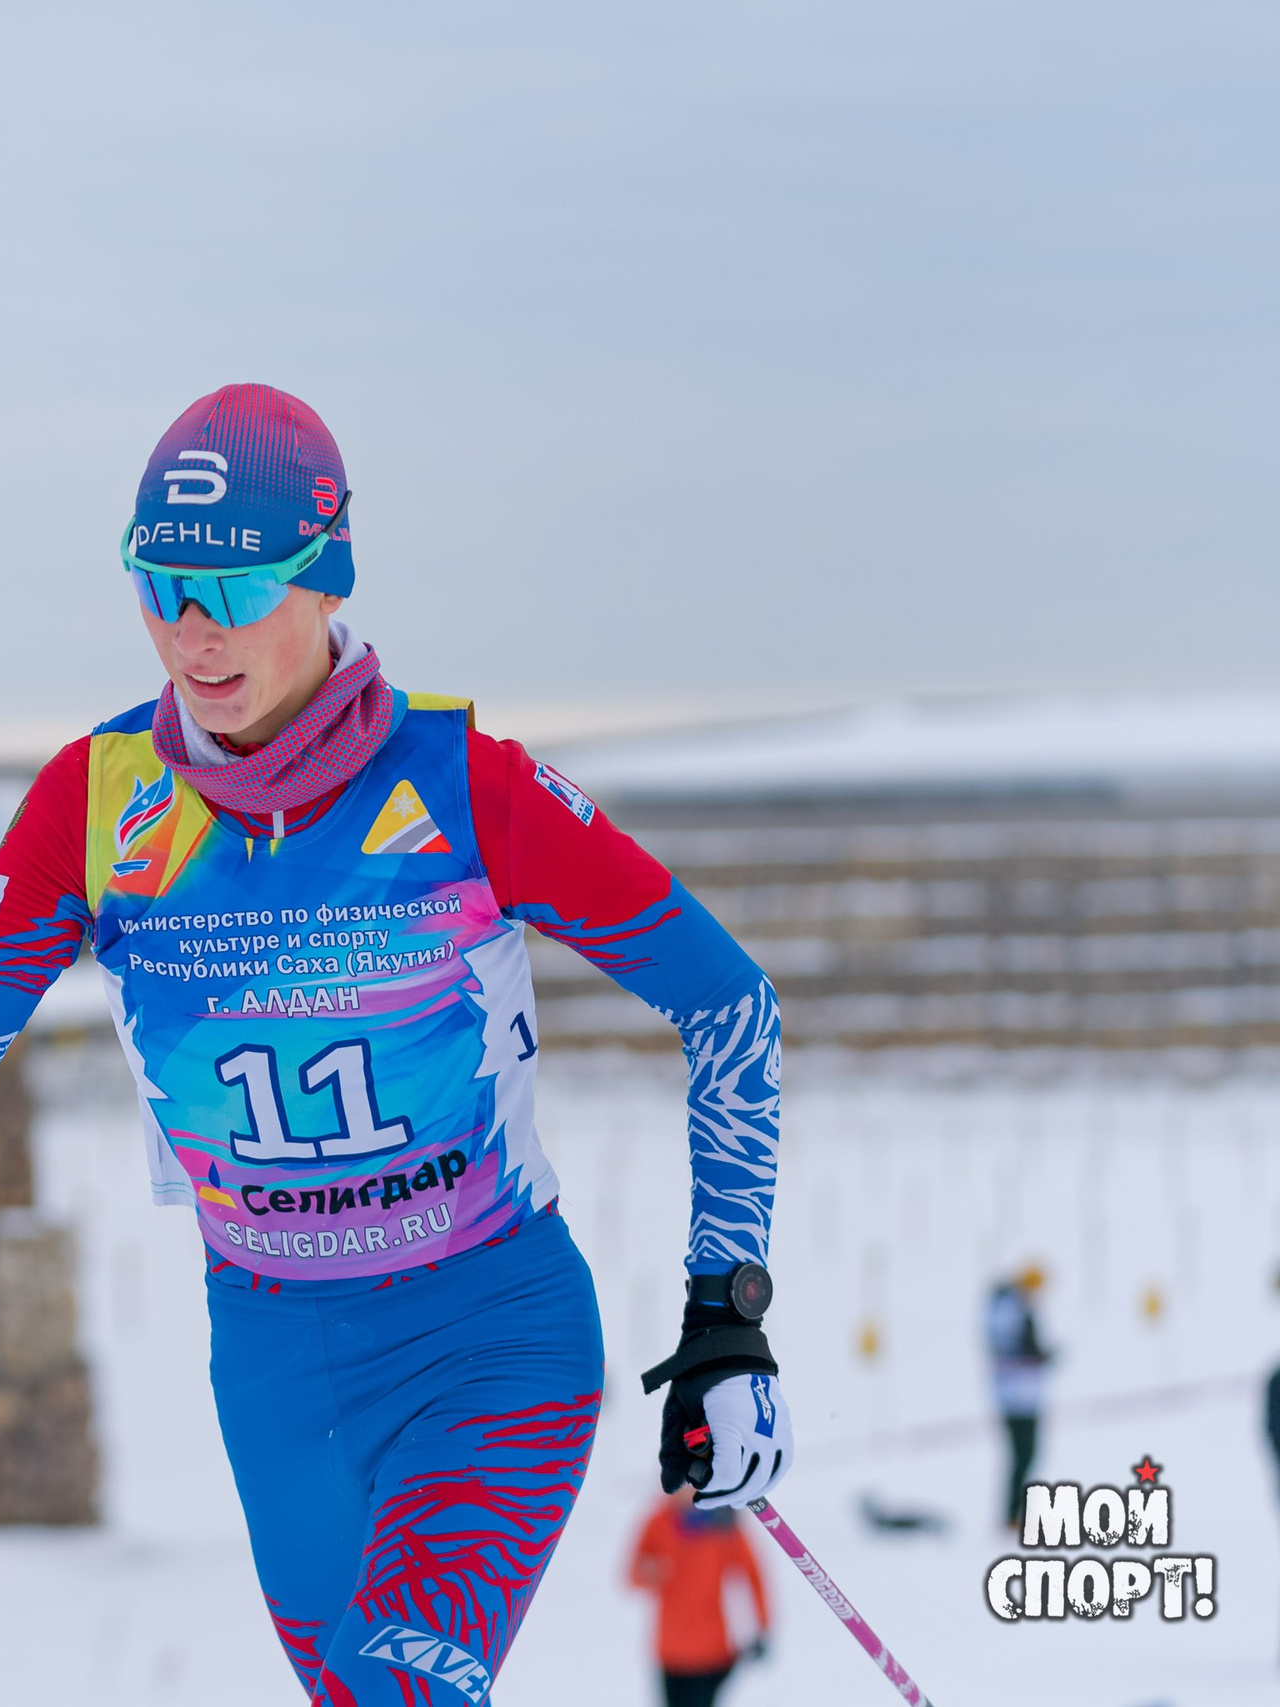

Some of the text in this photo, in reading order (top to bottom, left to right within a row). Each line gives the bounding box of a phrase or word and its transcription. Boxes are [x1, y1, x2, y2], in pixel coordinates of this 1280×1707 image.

[280, 907, 309, 925] по
[315, 893, 463, 927] физической
[127, 939, 457, 983] Республики Саха (Якутия)
[178, 928, 390, 958] культуре и спорту
[206, 986, 361, 1019] г. АЛДАН
[214, 1037, 414, 1164] 11
[240, 1148, 468, 1217] Селигдар
[224, 1203, 454, 1259] SELIGDAR.RU
